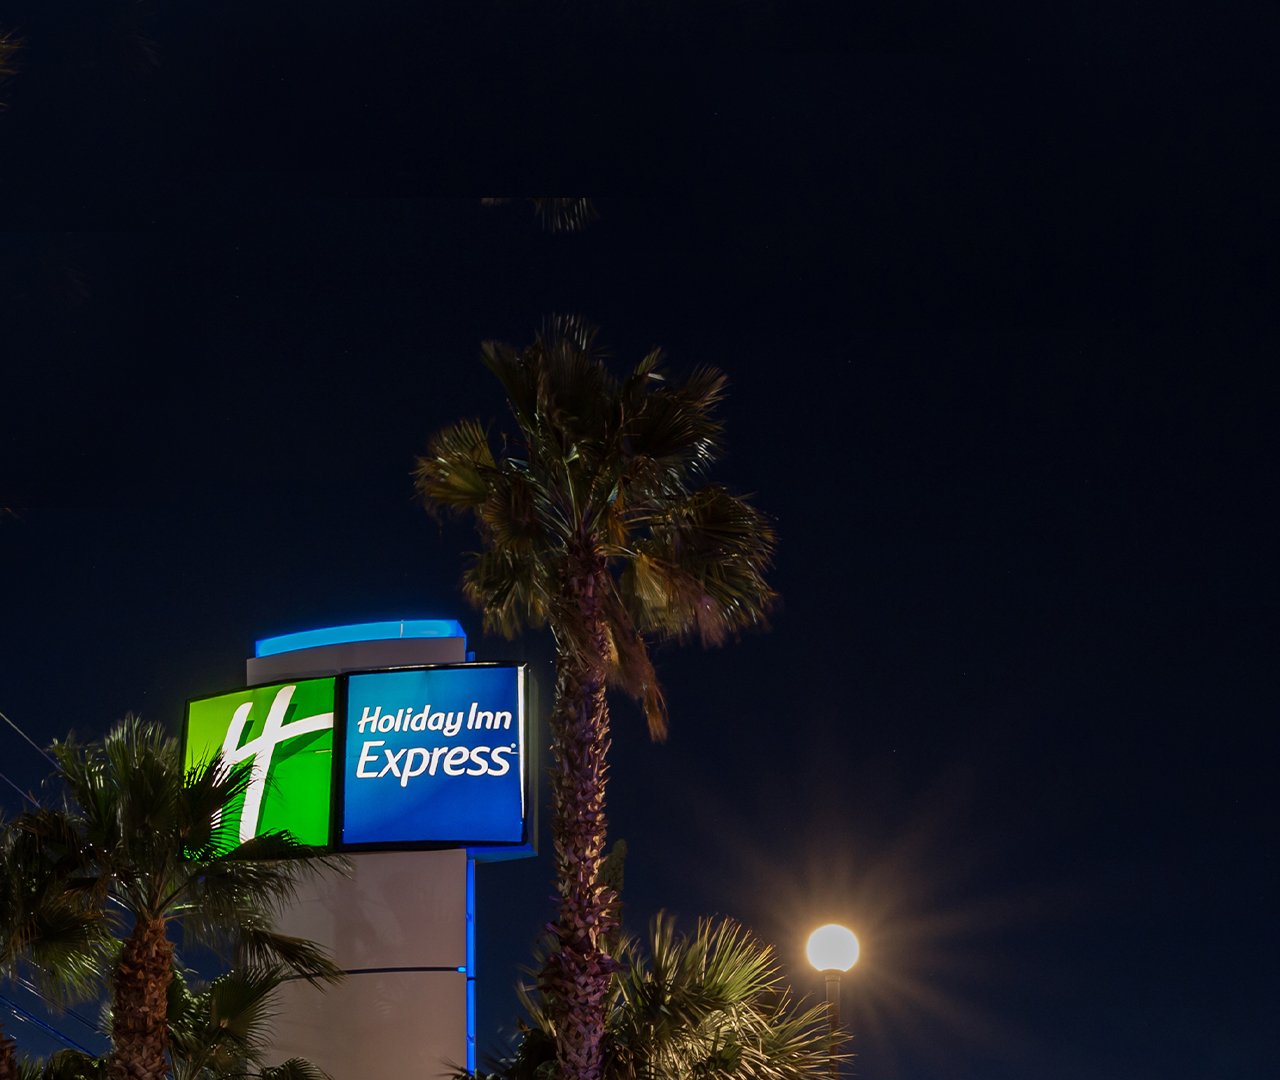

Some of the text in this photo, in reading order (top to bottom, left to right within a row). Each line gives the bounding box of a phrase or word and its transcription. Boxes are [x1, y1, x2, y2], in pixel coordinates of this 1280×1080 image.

[357, 702, 513, 737] Holiday Inn
[356, 740, 513, 788] Express
